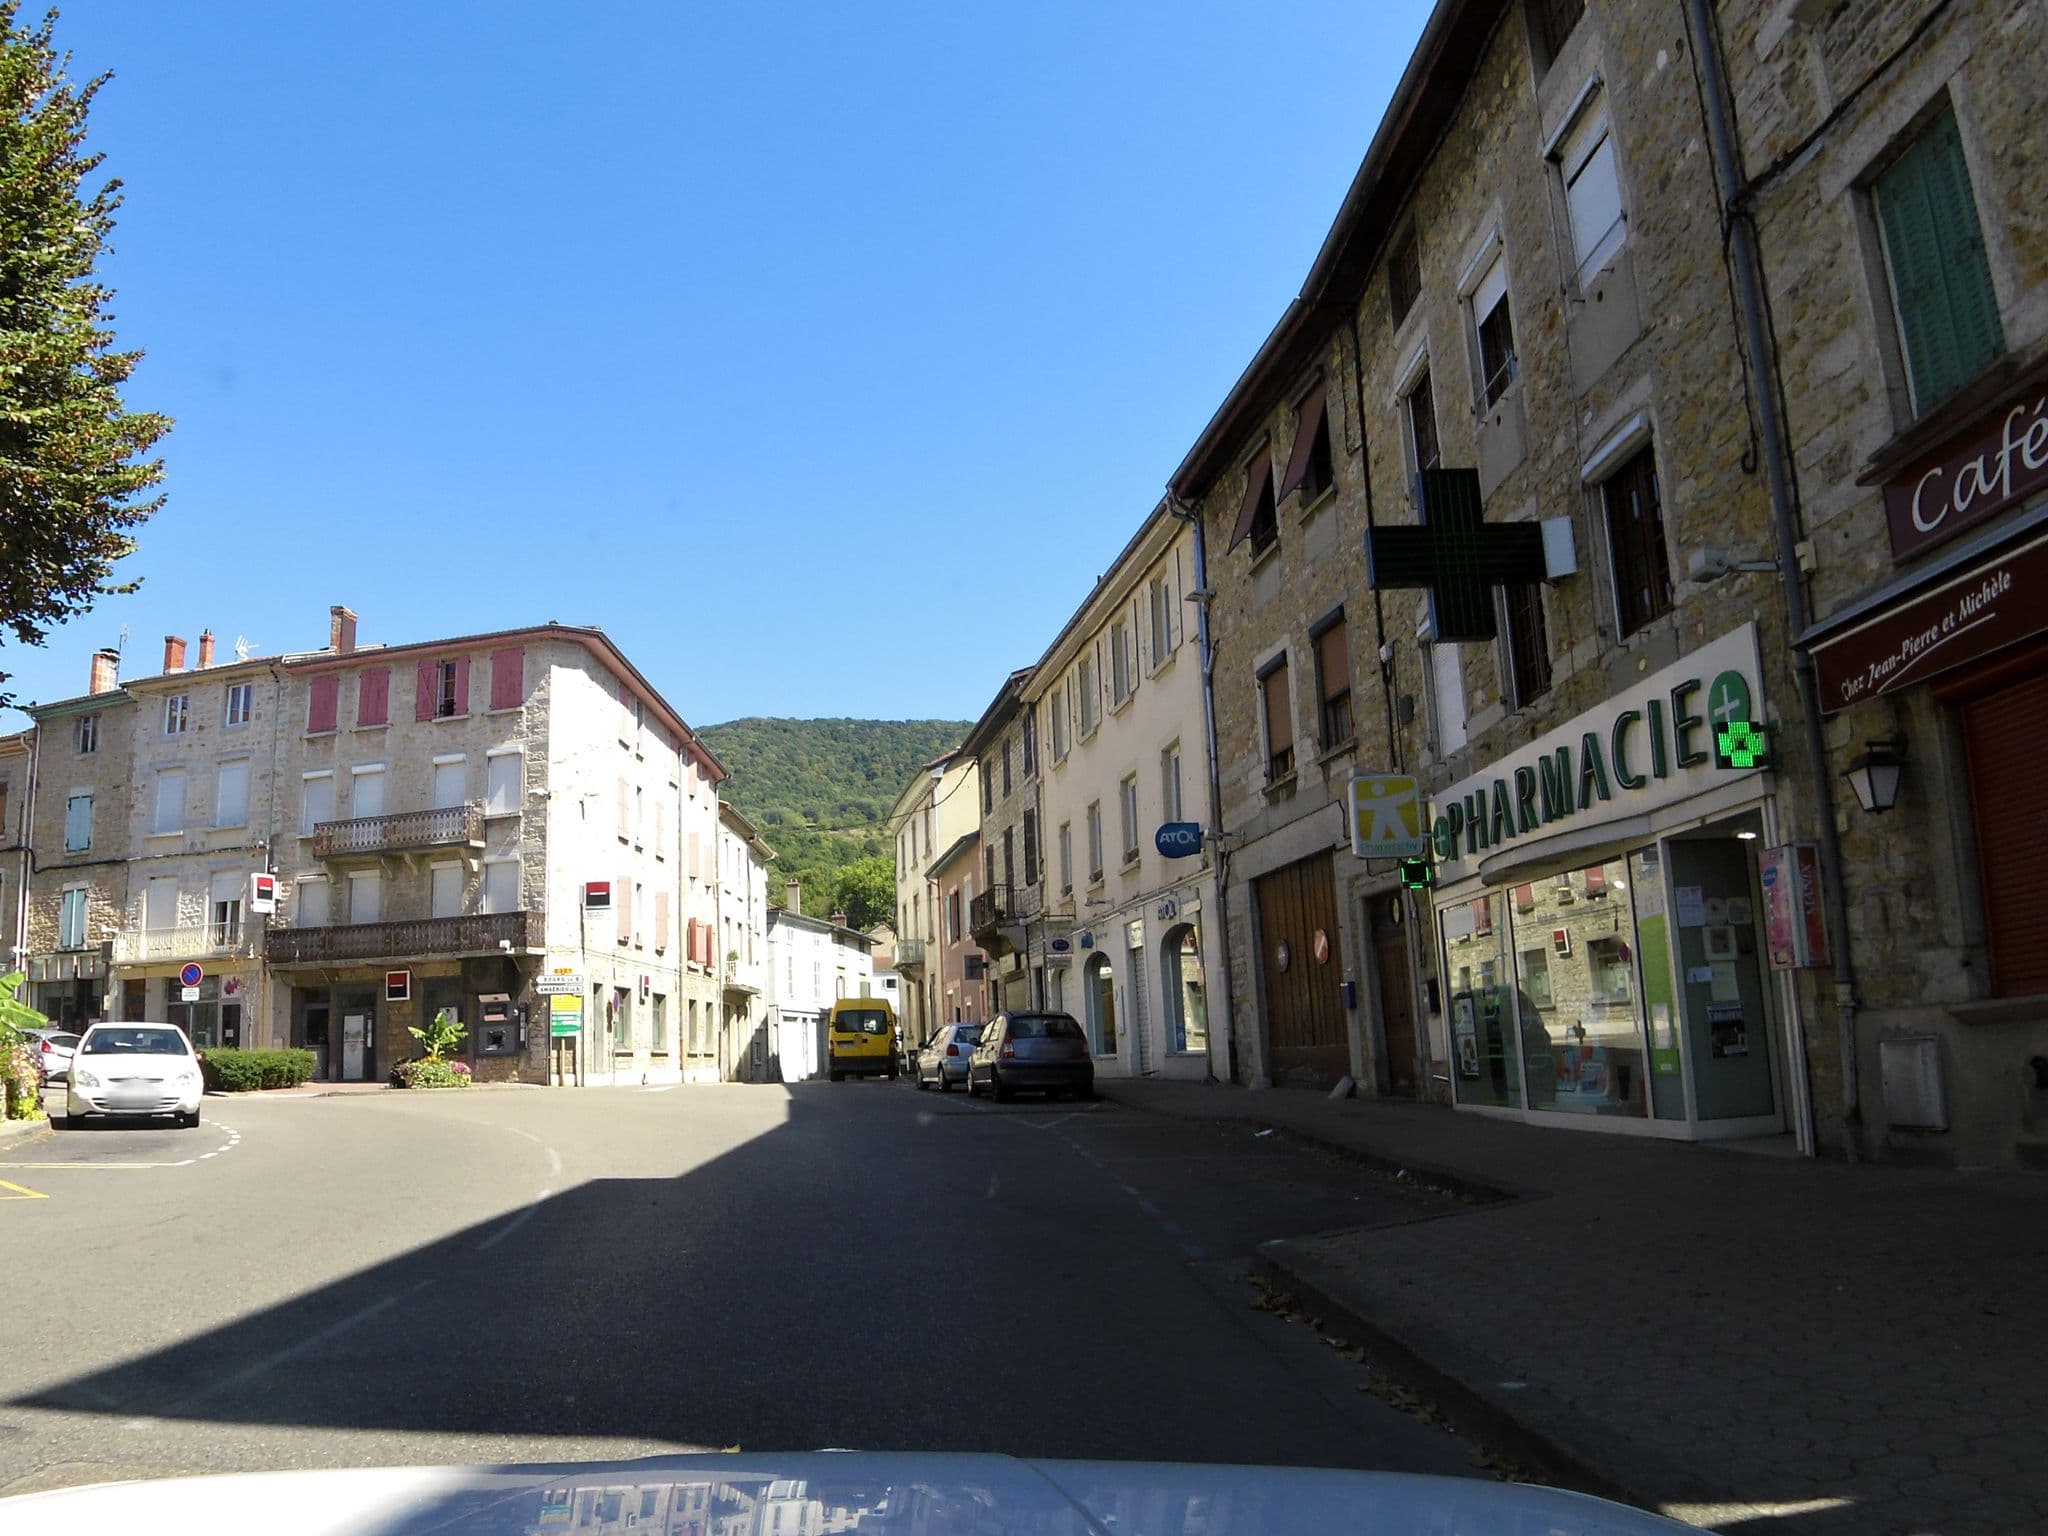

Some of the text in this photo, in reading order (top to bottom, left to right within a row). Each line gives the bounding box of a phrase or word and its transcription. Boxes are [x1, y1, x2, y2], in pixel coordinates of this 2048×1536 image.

[1911, 396, 2048, 533] Café
[1841, 570, 2012, 702] Chez Jean-Pierre et Michèle
[1446, 678, 1708, 861] PHARMACIE
[1159, 830, 1196, 844] ATOL
